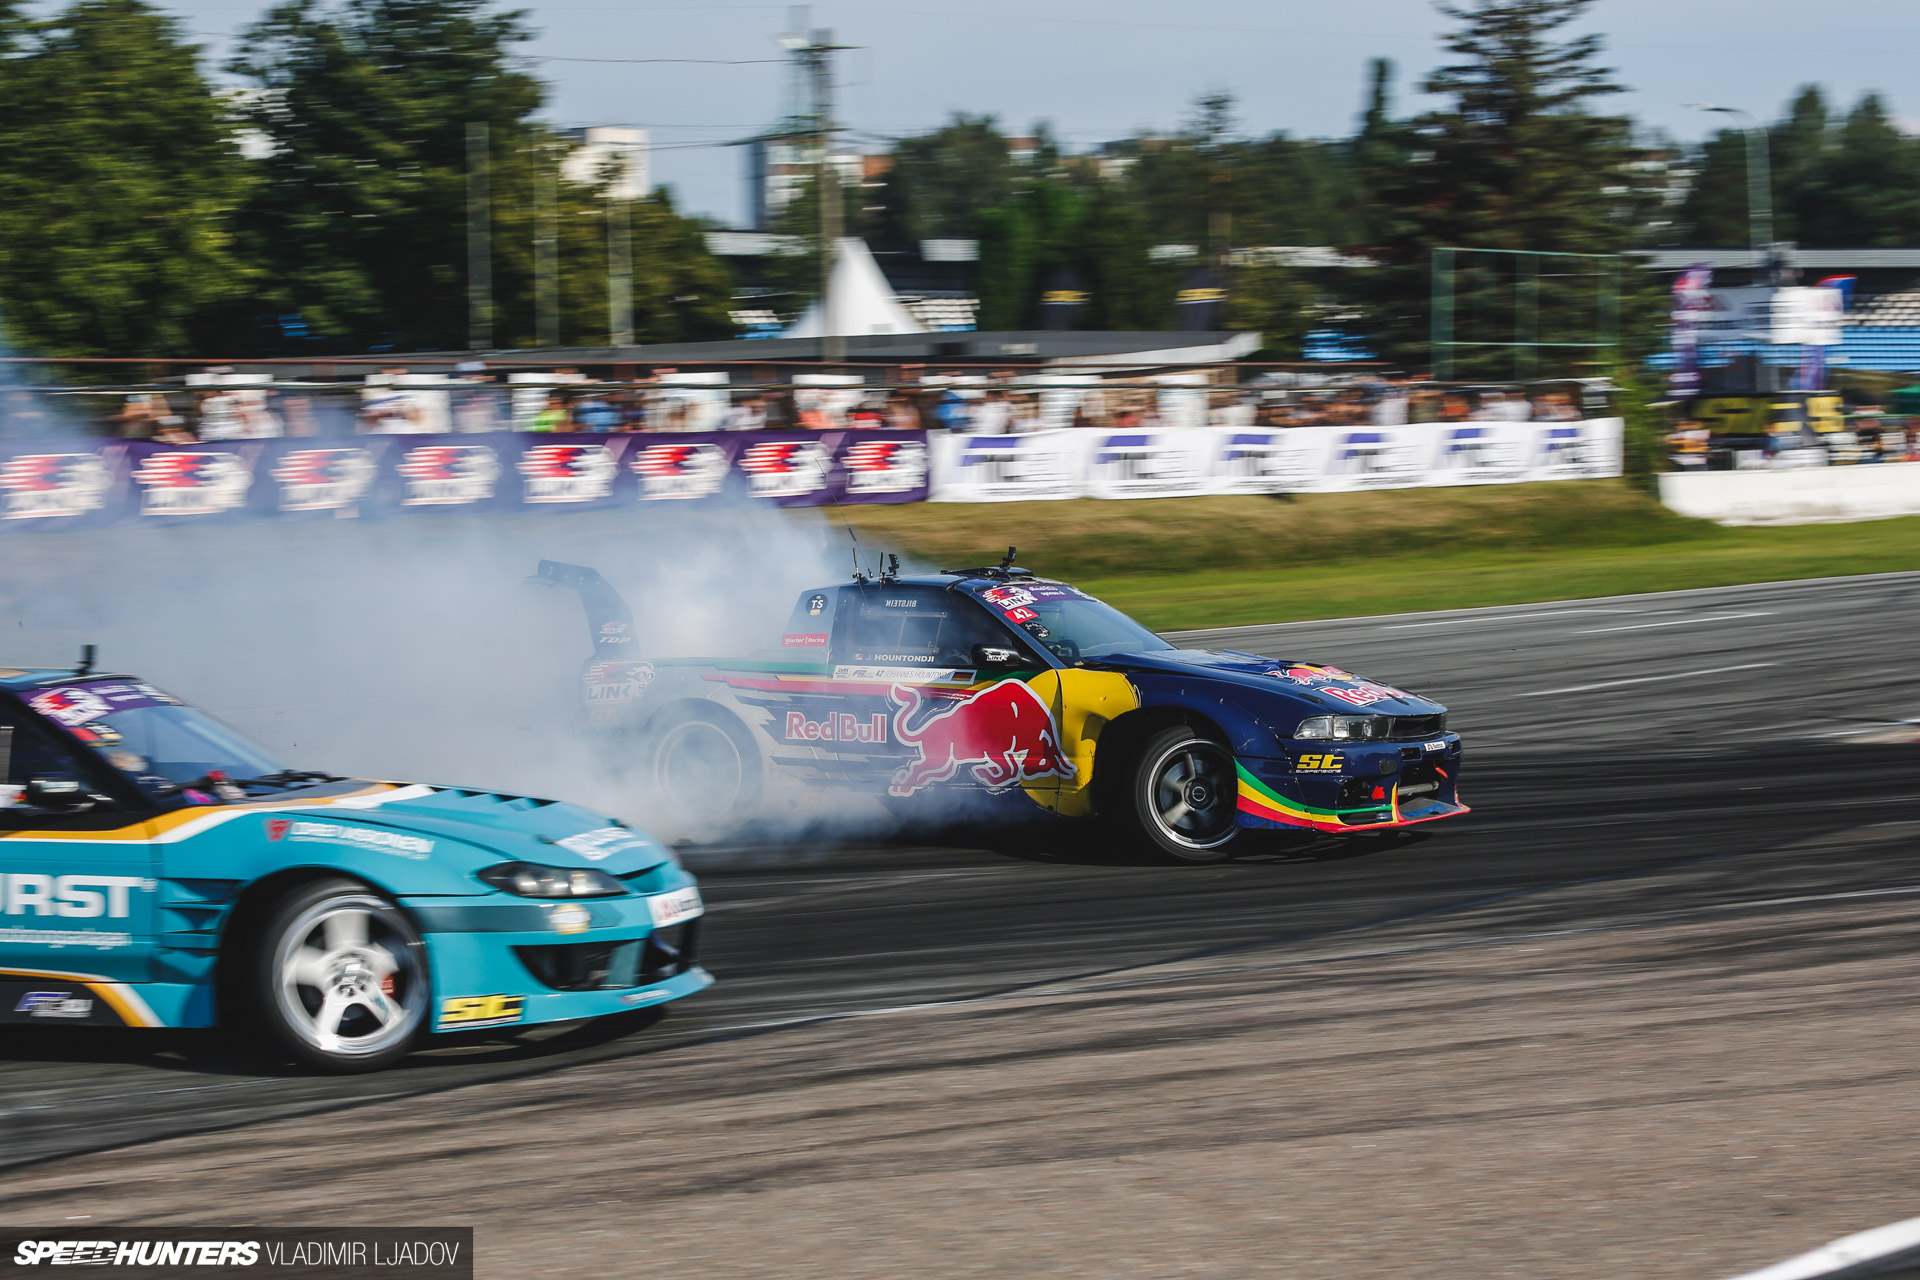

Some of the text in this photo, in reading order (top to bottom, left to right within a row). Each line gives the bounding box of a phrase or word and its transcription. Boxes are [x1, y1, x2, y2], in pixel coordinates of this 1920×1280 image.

[811, 599, 824, 609] TS
[1012, 608, 1033, 620] 42
[874, 654, 935, 663] HOUNTONDJI
[786, 711, 887, 743] Red Bull
[0, 873, 144, 918] RST
